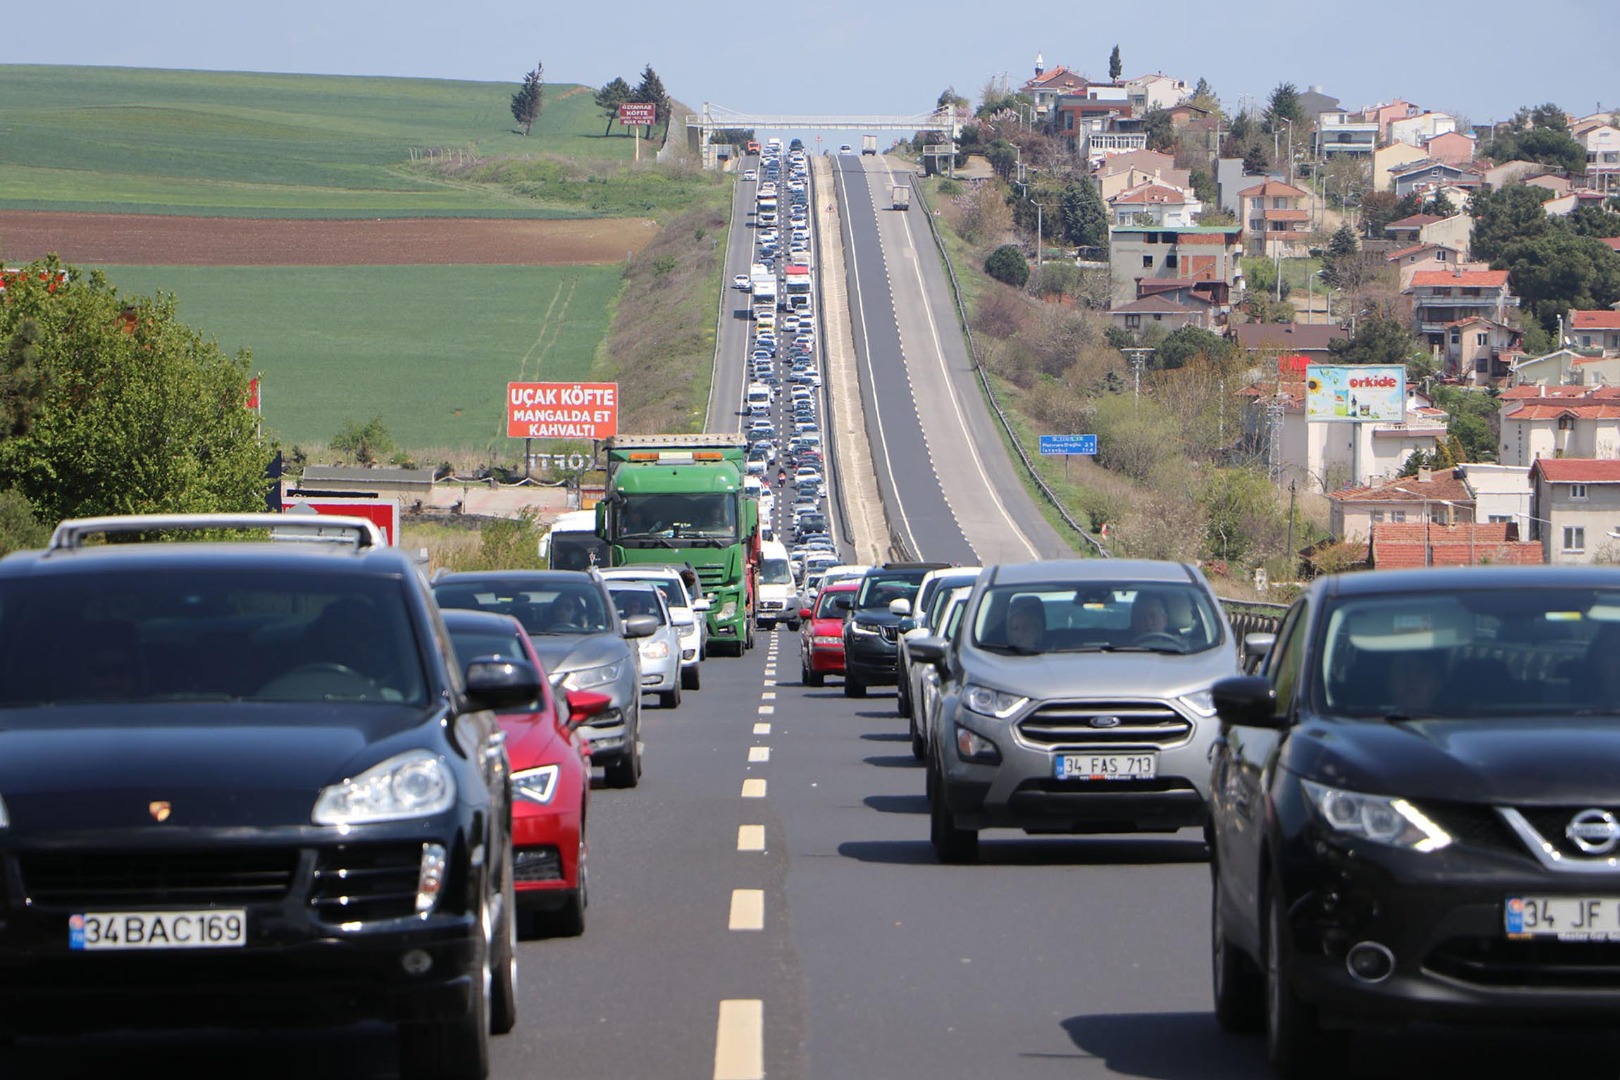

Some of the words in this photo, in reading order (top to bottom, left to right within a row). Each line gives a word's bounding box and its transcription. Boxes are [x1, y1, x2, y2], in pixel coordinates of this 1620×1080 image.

[1349, 375, 1397, 388] orkide
[511, 388, 557, 407] UÇAK
[560, 385, 614, 406] KÖFTE
[513, 410, 591, 422] MANGALDA
[593, 410, 611, 422] ET
[529, 424, 595, 436] KAHVALTI
[1065, 757, 1082, 773] 34
[1091, 757, 1118, 773] FAS
[1127, 757, 1151, 773] 713
[1524, 901, 1555, 928] 34
